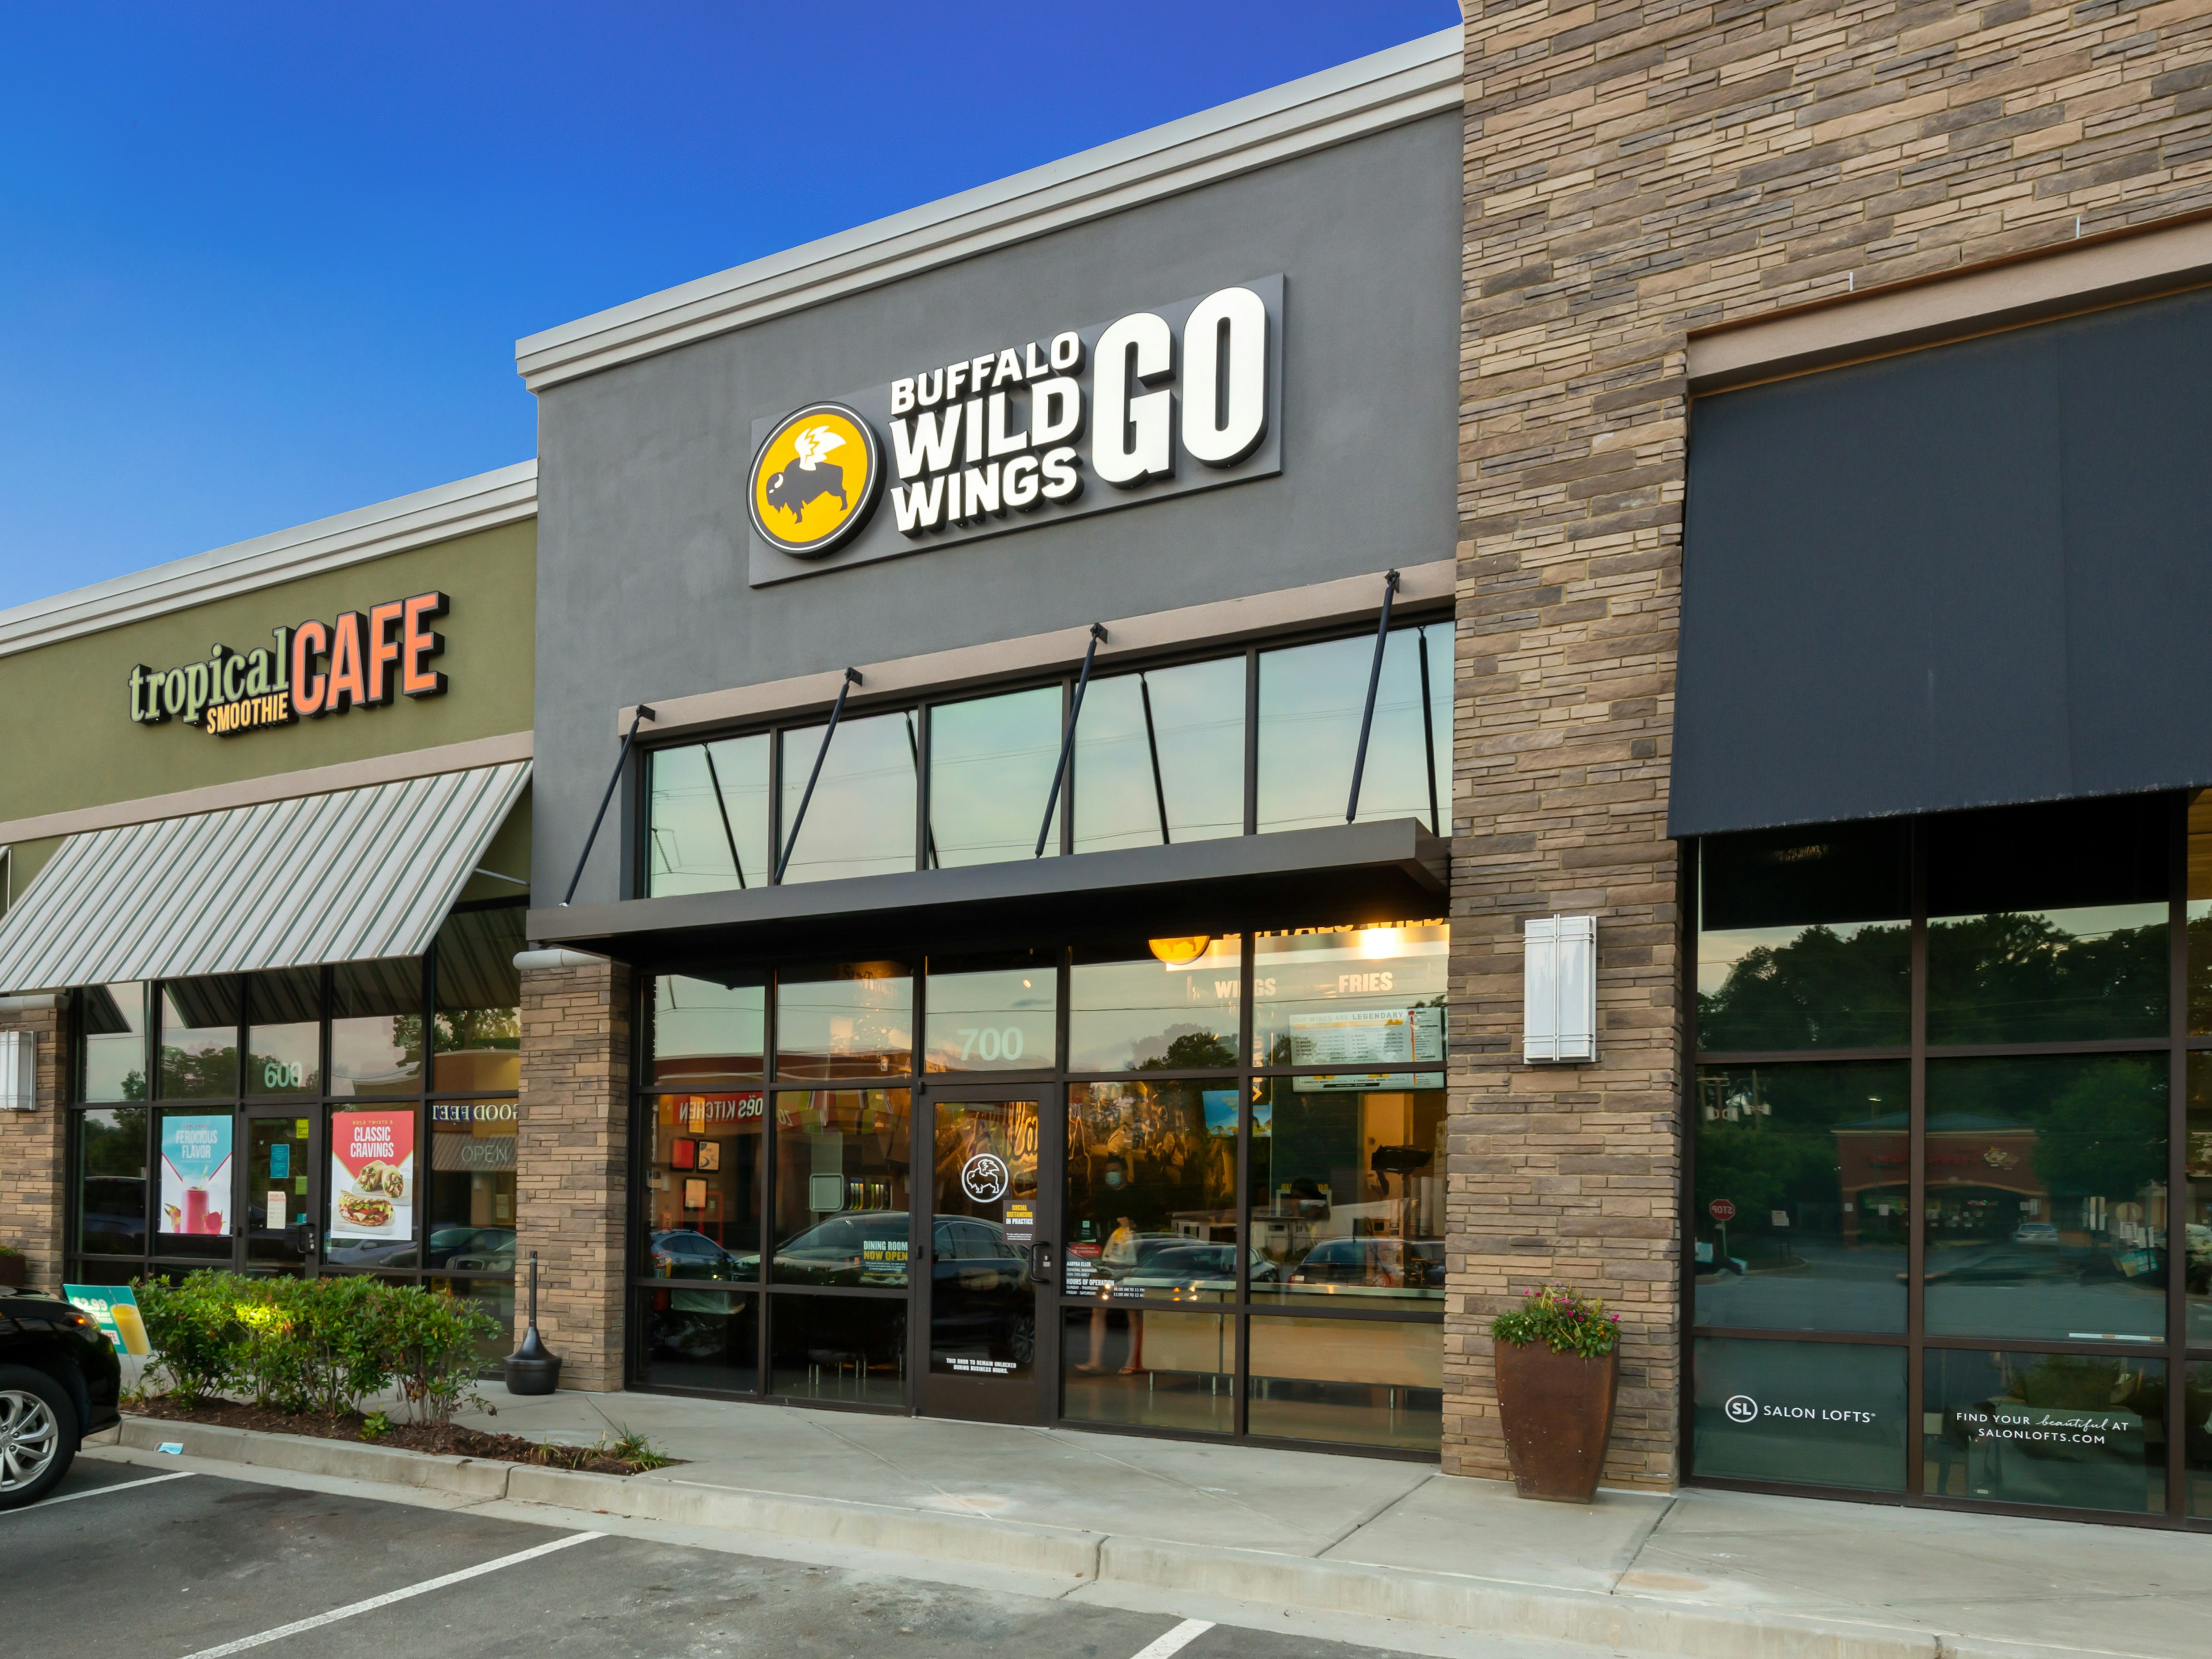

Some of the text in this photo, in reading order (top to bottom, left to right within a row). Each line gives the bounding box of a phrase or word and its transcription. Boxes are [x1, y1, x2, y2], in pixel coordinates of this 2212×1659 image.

[891, 331, 1080, 415] BUFFALO
[1092, 286, 1266, 482] GO
[889, 377, 1080, 479] WILD
[891, 447, 1077, 532] WINGS
[128, 591, 440, 723] tropical CAFE
[207, 692, 288, 735] SMOOTHIE
[1338, 972, 1393, 993] FRIES
[1353, 1012, 1403, 1020] LEGENDARY
[957, 1026, 1024, 1061] 700
[264, 1061, 302, 1088] 600
[176, 1130, 218, 1144] FEROCIOUS
[354, 1126, 391, 1142] CLASSIC
[182, 1145, 211, 1158] FLAVOR
[350, 1142, 394, 1157] CRAVINGS
[462, 1145, 507, 1162] OPEN
[863, 1241, 908, 1251] DINING ROOM
[863, 1251, 908, 1261] NOW OPEN
[1732, 1402, 1752, 1416] SL
[1763, 1405, 1815, 1419] SALON
[1956, 1412, 2129, 1432] FIND YOUR beautiful AT
[1978, 1428, 2105, 1444] SALONLOFTS.COM
